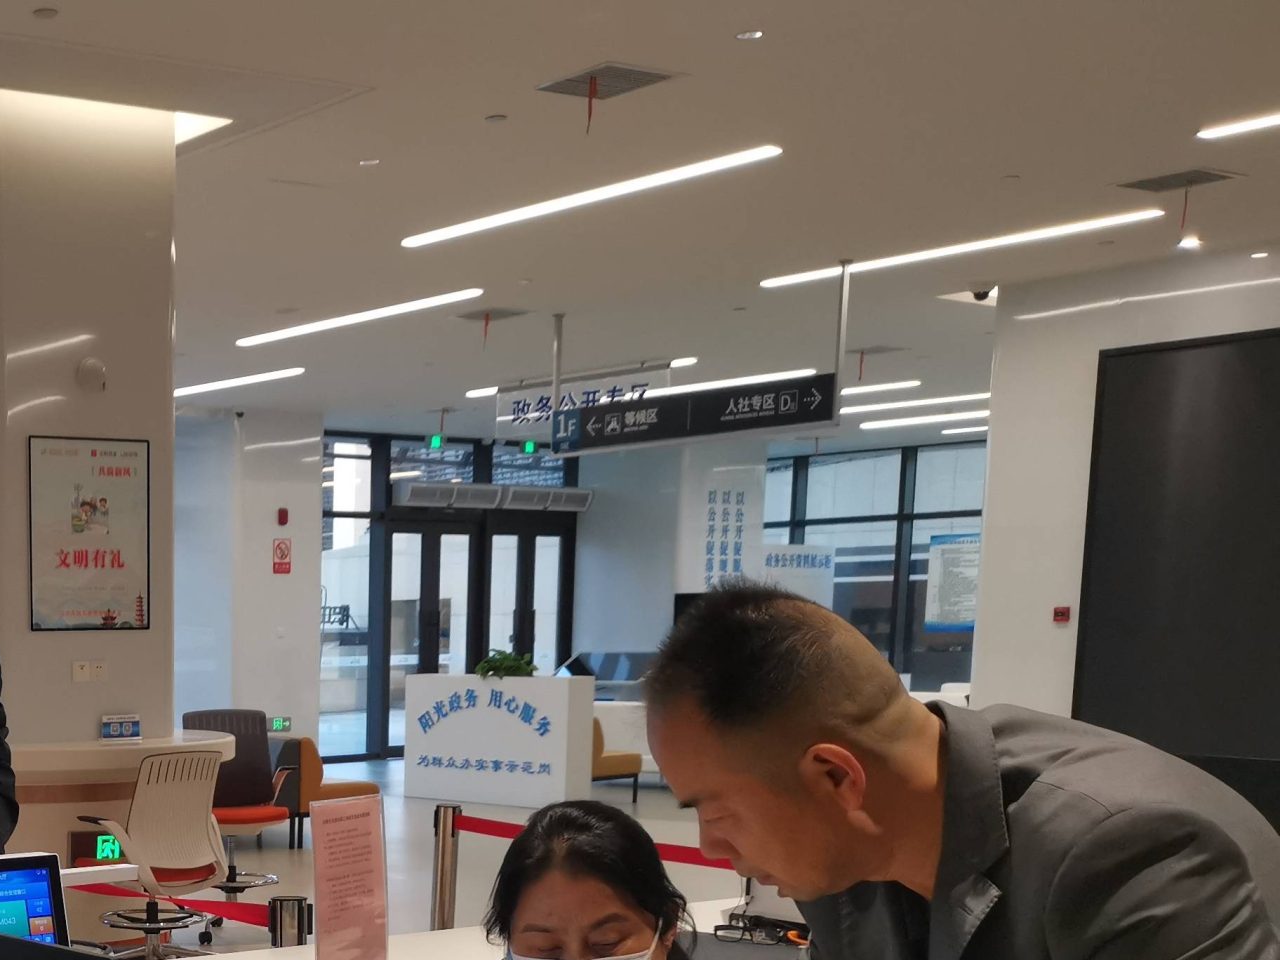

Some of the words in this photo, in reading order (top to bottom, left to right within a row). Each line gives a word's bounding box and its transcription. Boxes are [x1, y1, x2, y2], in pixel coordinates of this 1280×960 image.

[725, 393, 776, 414] 人社专区
[555, 413, 577, 439] 1F
[624, 408, 658, 426] 等候区
[56, 549, 125, 570] 文明有礼
[417, 688, 479, 735] 阳光政务
[487, 688, 553, 737] 用心服务
[416, 754, 552, 776] 为群众办实事示范岗
